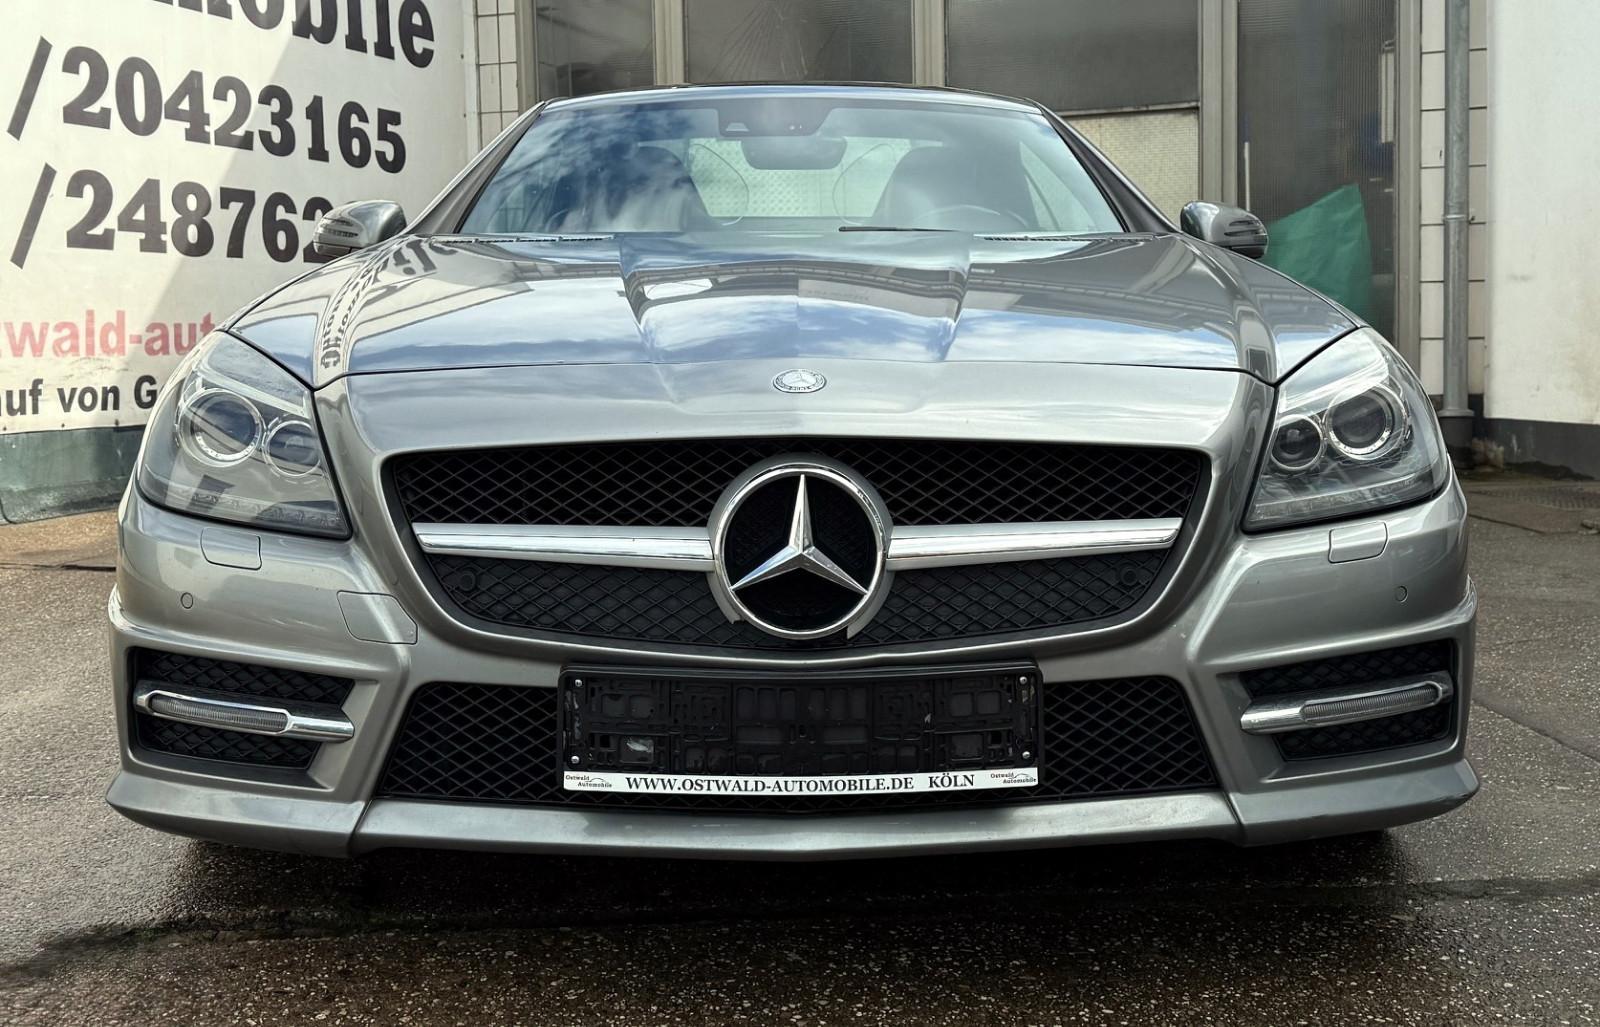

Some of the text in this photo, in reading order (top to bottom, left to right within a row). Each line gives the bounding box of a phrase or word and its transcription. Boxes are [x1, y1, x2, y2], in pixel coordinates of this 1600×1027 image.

[0, 378, 43, 417] uf
[57, 384, 121, 413] von
[626, 772, 975, 793] WWW.OSTWALD-AUTOMOBILE.DE KÖLN
